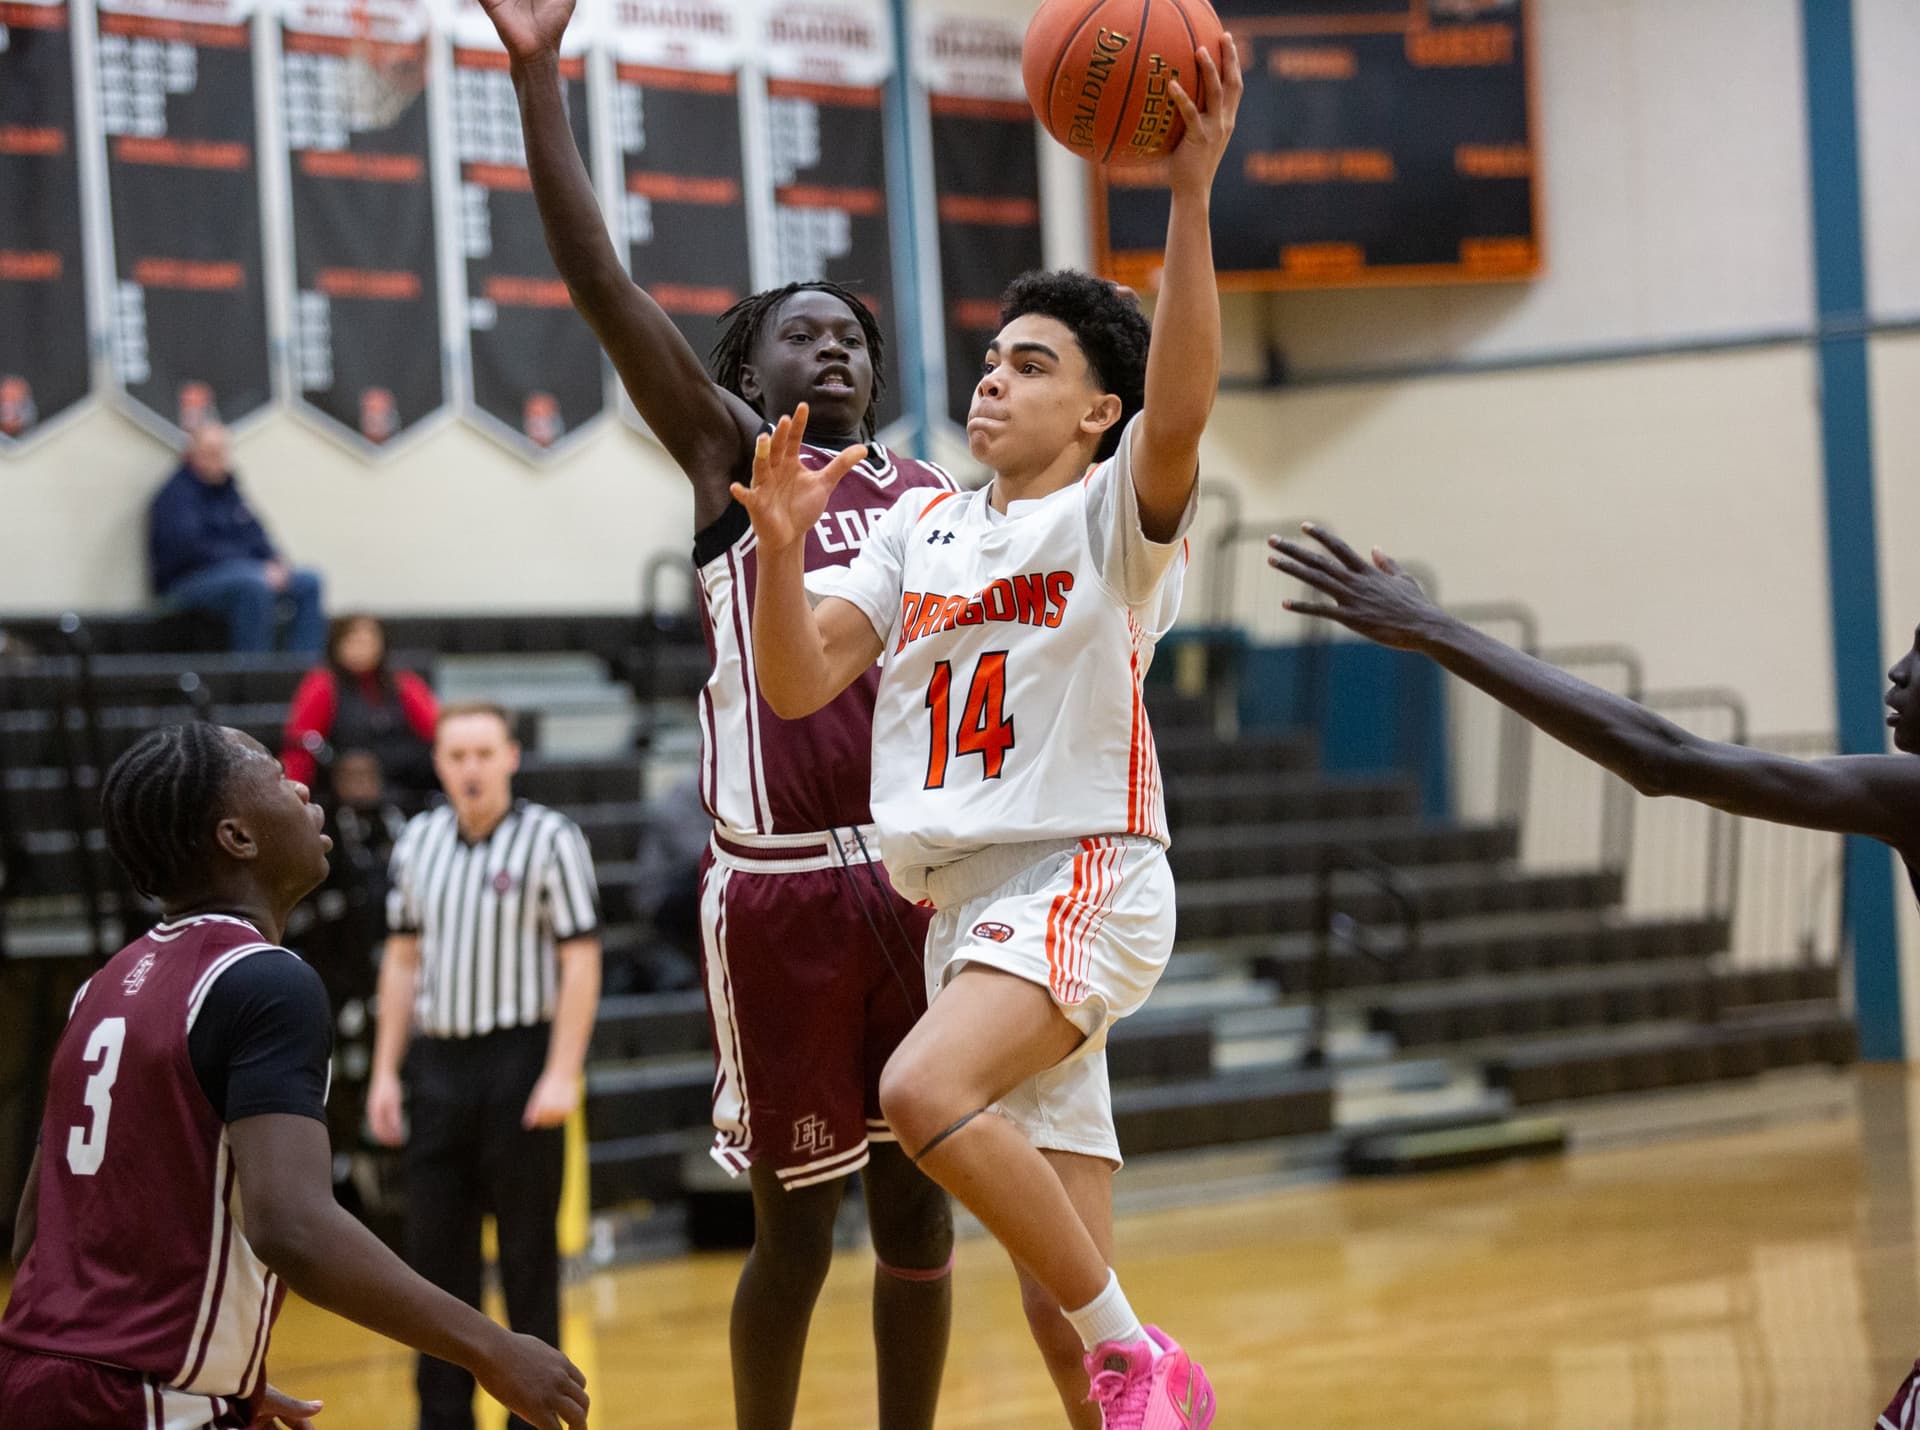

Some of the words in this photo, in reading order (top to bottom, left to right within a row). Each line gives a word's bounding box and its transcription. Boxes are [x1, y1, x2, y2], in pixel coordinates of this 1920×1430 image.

[1068, 26, 1131, 152] SPALDING
[895, 571, 1075, 656] DRAGONS
[923, 649, 1015, 790] 14
[66, 1017, 126, 1176] 3
[793, 1114, 836, 1154] EL
